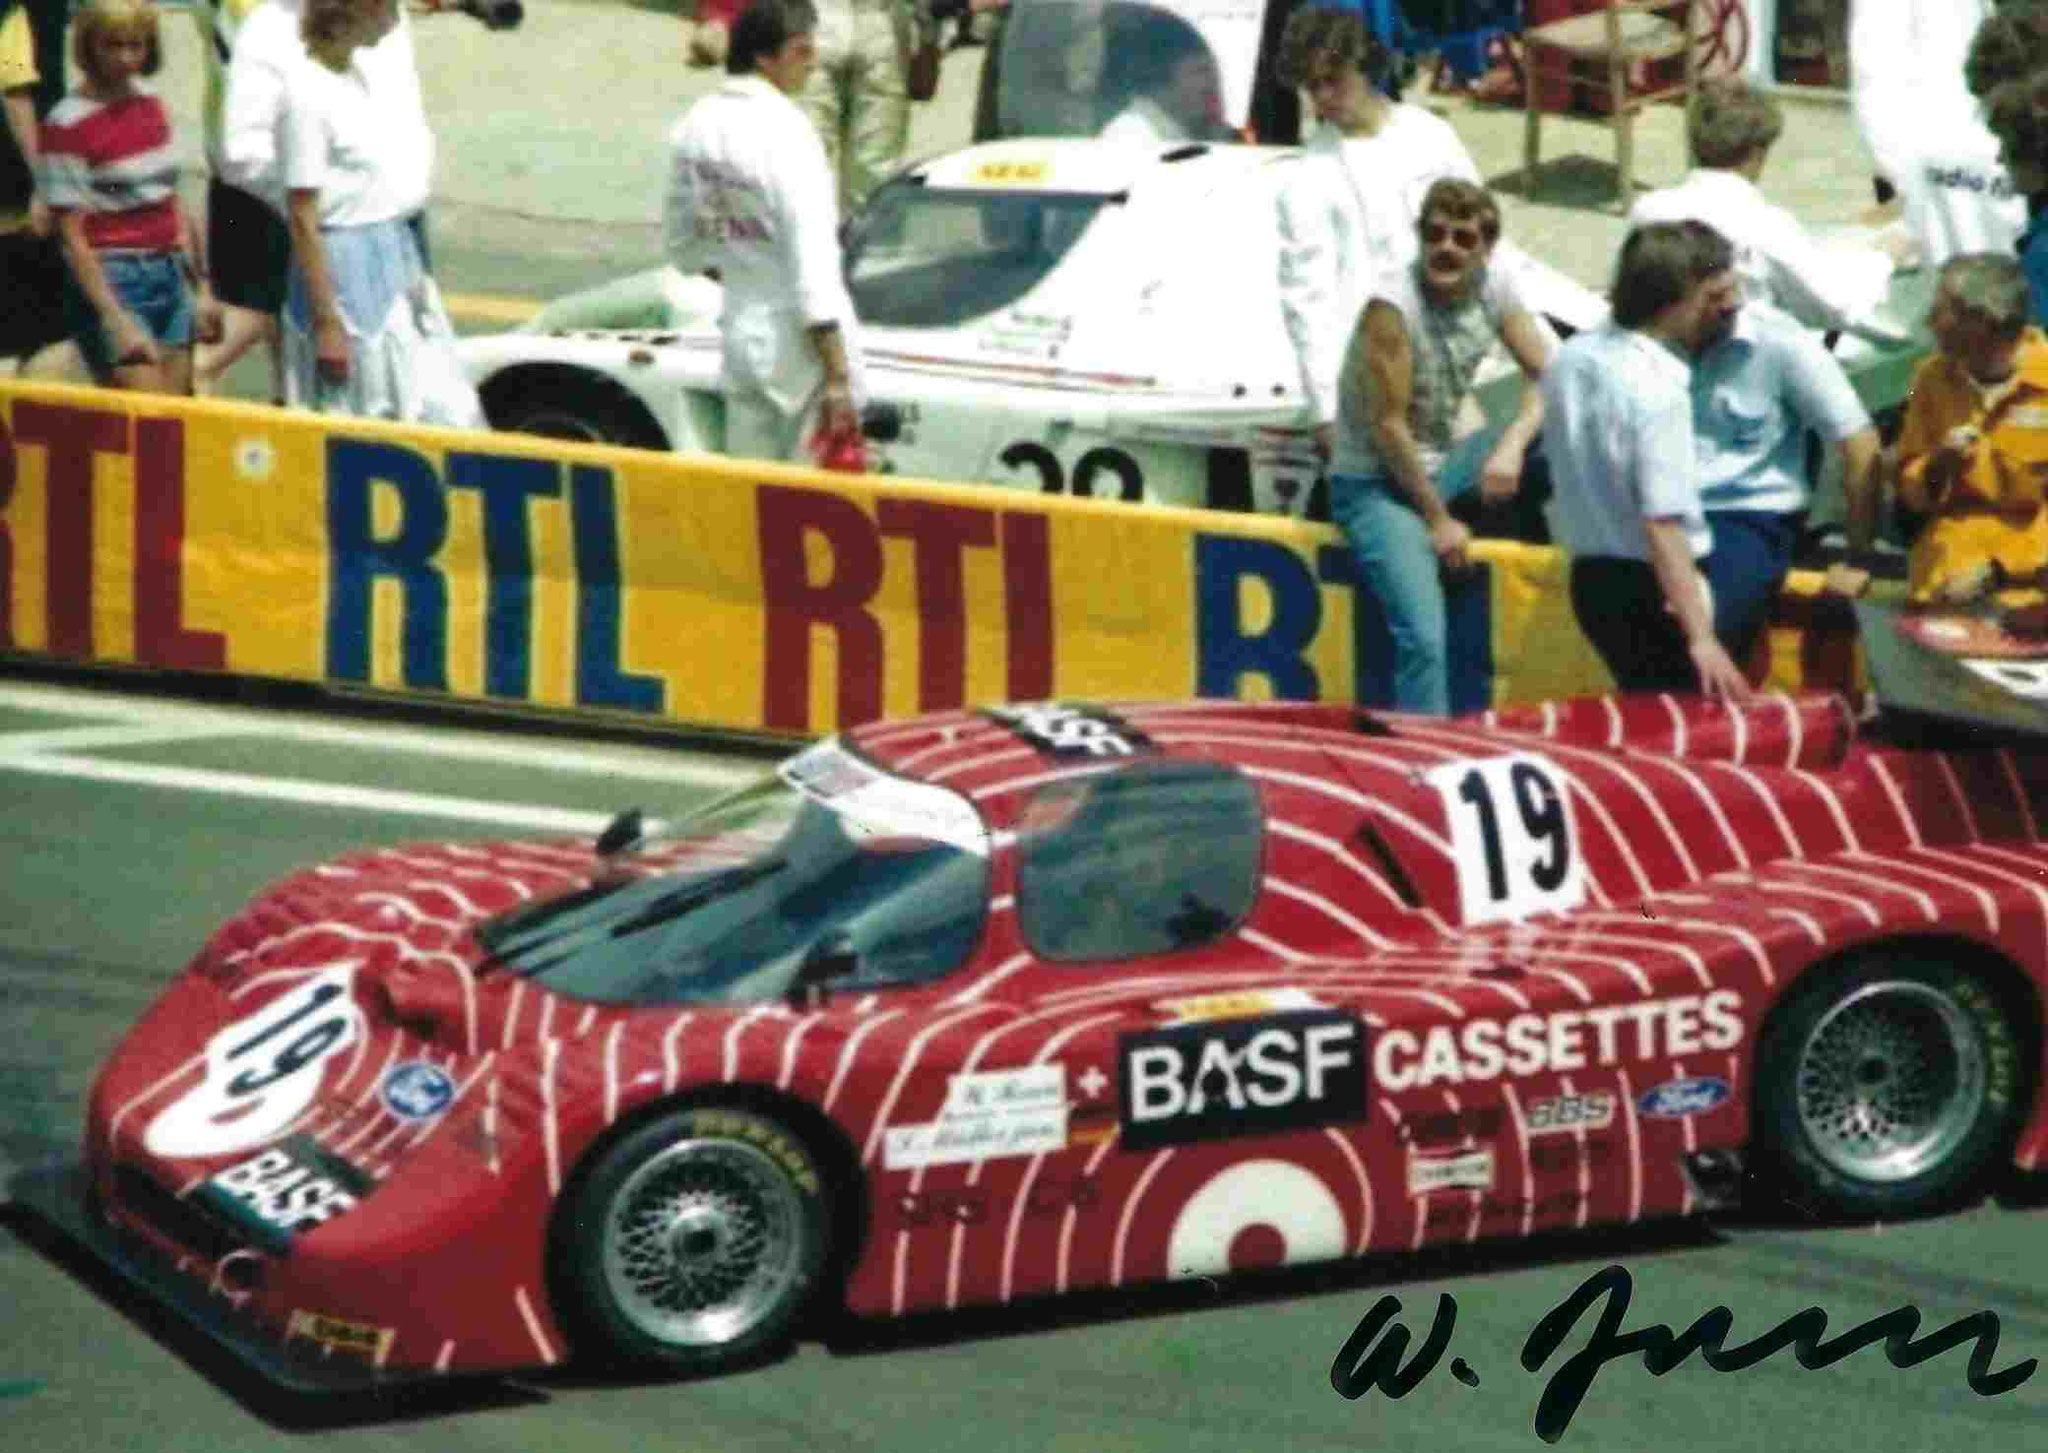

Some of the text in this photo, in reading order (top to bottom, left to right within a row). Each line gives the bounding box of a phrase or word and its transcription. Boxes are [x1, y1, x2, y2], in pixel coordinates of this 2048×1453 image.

[0, 398, 226, 670] TL
[325, 436, 666, 714] RTL
[1460, 760, 1571, 900] 19
[225, 984, 348, 1097] 19
[1129, 990, 1743, 1122] BASF CASSETTES
